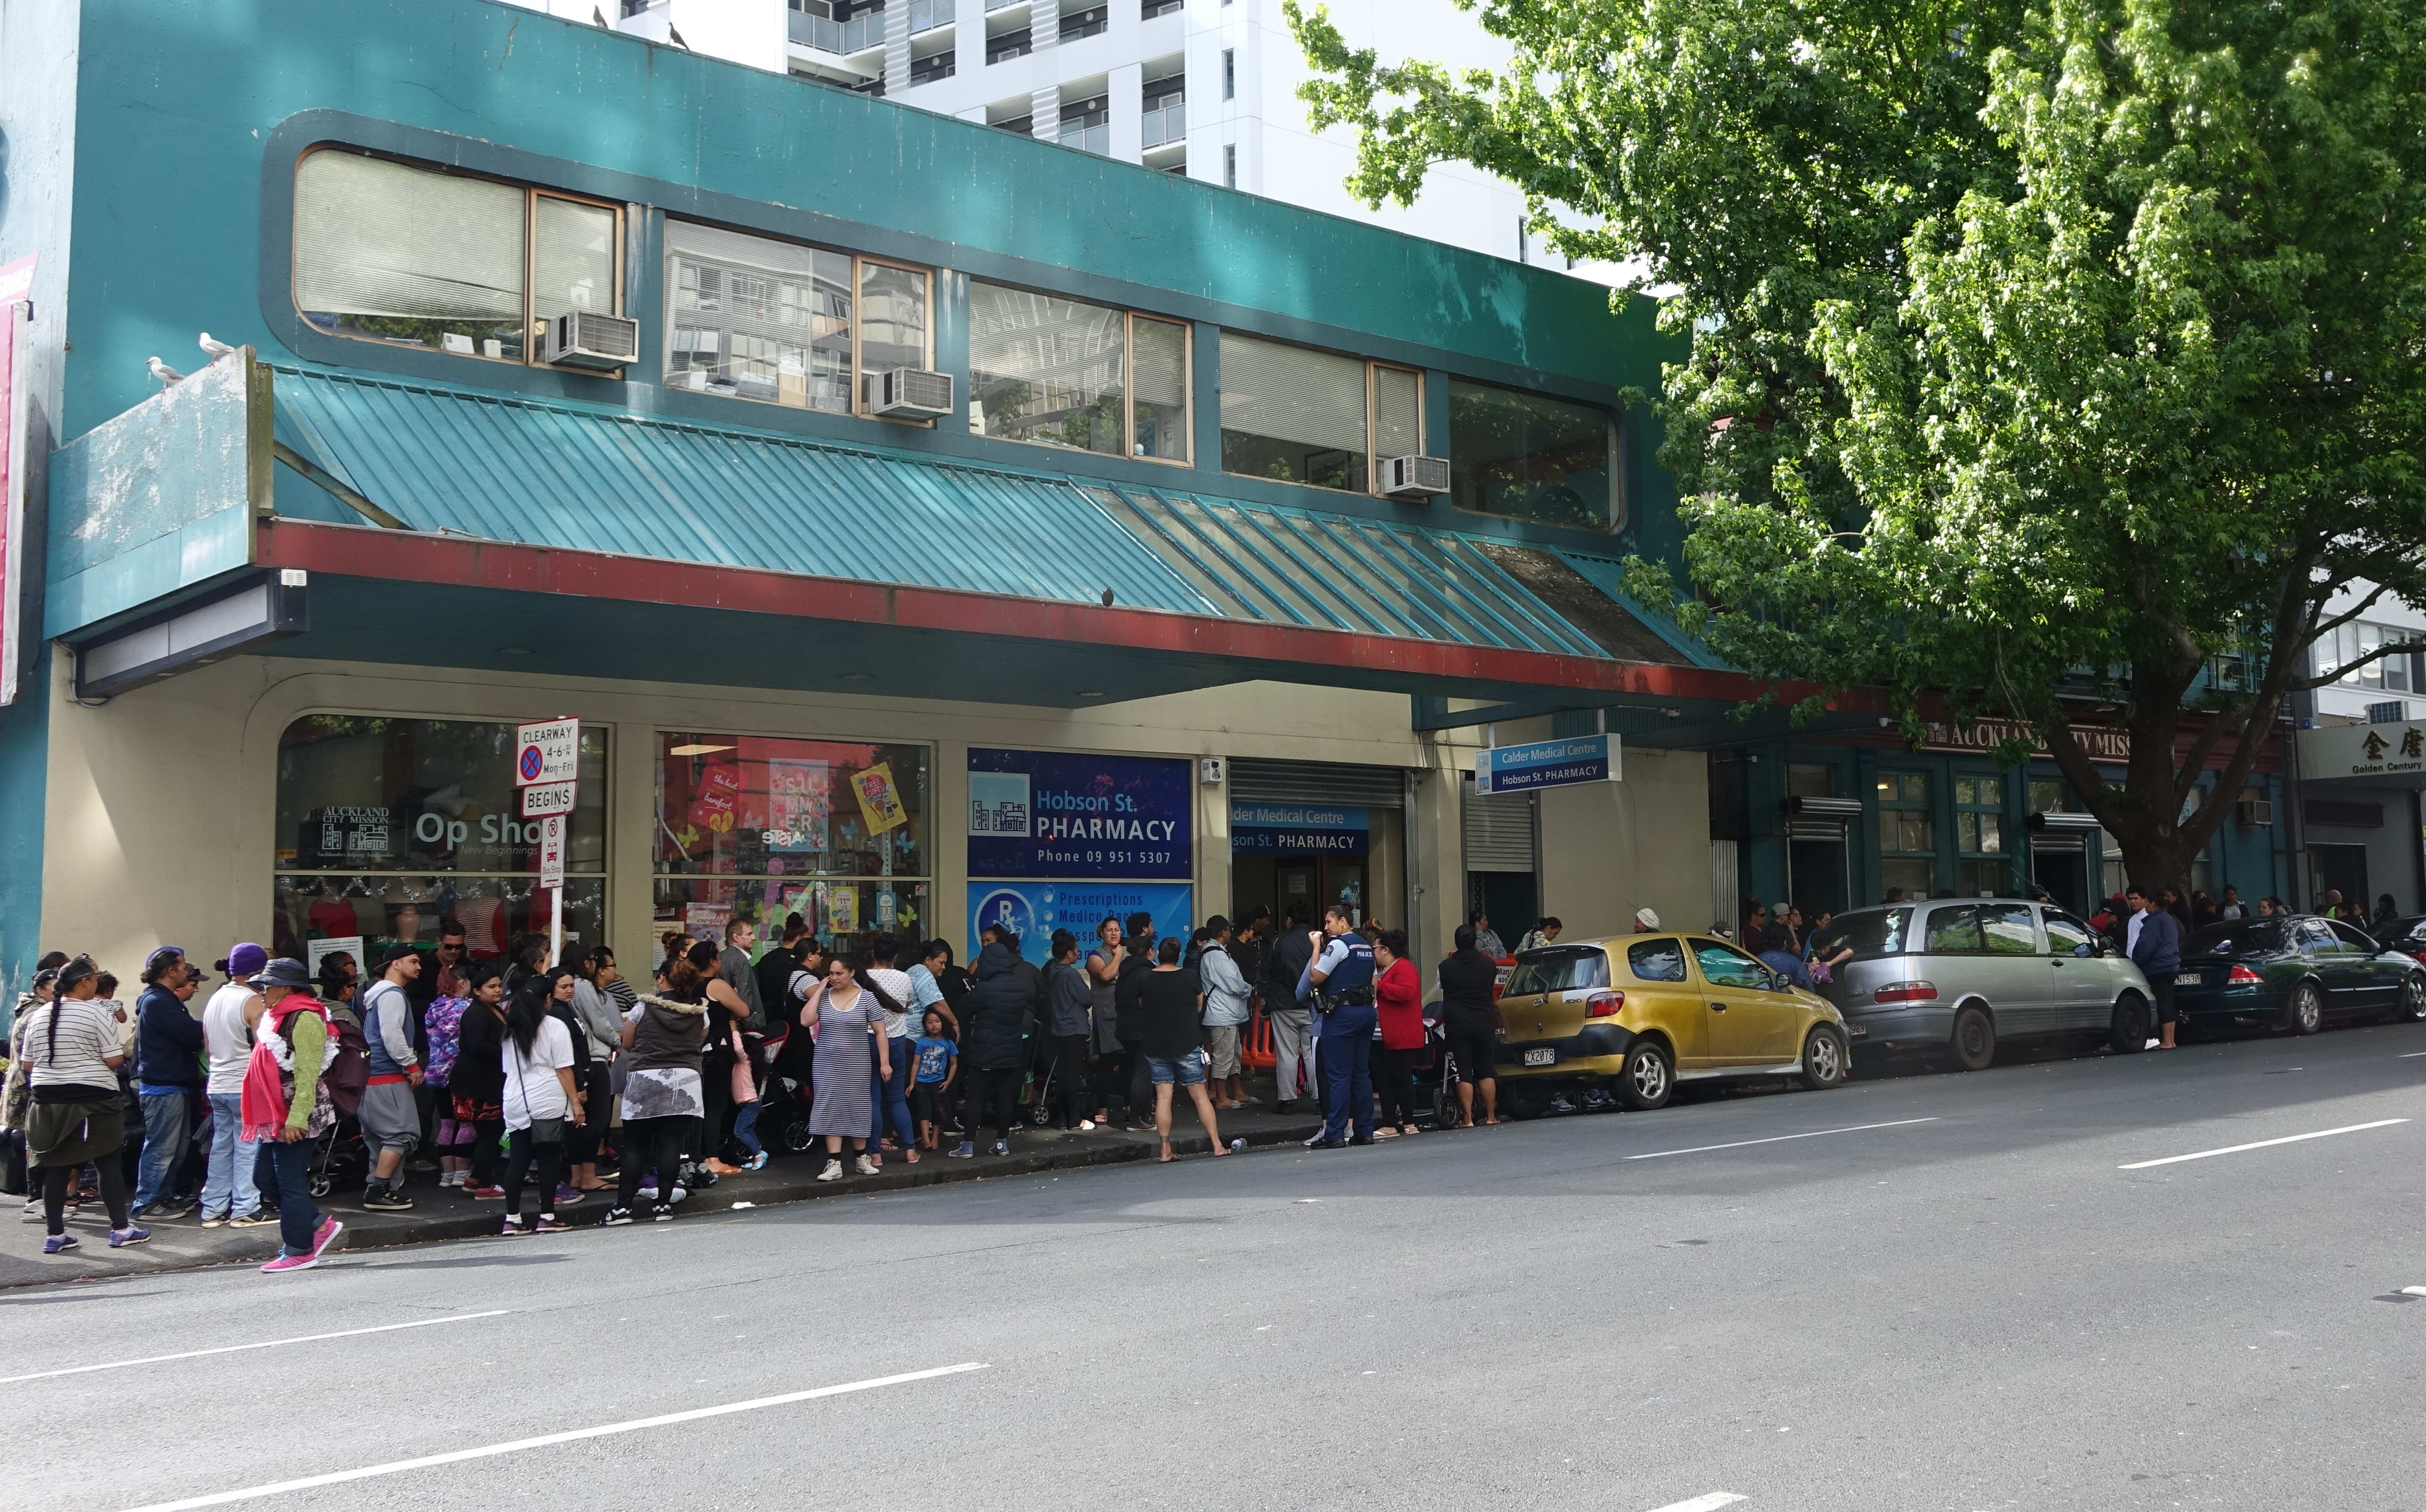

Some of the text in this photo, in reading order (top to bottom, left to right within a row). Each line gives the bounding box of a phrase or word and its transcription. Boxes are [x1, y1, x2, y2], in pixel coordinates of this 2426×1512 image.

[523, 726, 573, 743] CLEARWAY
[1502, 744, 1596, 764] Calder Medical Centre
[543, 762, 574, 774] Mon-Fri
[1502, 765, 1597, 785] Hobson St. PHARMACY
[2352, 762, 2422, 774] Golden Century
[714, 774, 738, 790] the best
[866, 778, 881, 790] FREE
[527, 789, 570, 809] BEGINS
[704, 792, 733, 810] barefoot
[1037, 790, 1138, 812] Hobson St.
[323, 806, 389, 817] AUCKLAND
[1230, 806, 1344, 824] lder Medical Centre
[416, 813, 542, 851] Op Sho
[1038, 817, 1176, 841] PHARMACY
[1258, 834, 1272, 847] St.
[1279, 835, 1354, 849] PHARMACY
[460, 846, 538, 857] New Beginnings
[1038, 849, 1170, 863] Phone 09 951 5307
[551, 865, 562, 874] Stop
[1060, 893, 1143, 907] Prescriptions
[1060, 909, 1102, 923] Medico
[1526, 1050, 1554, 1063] ZX2078
